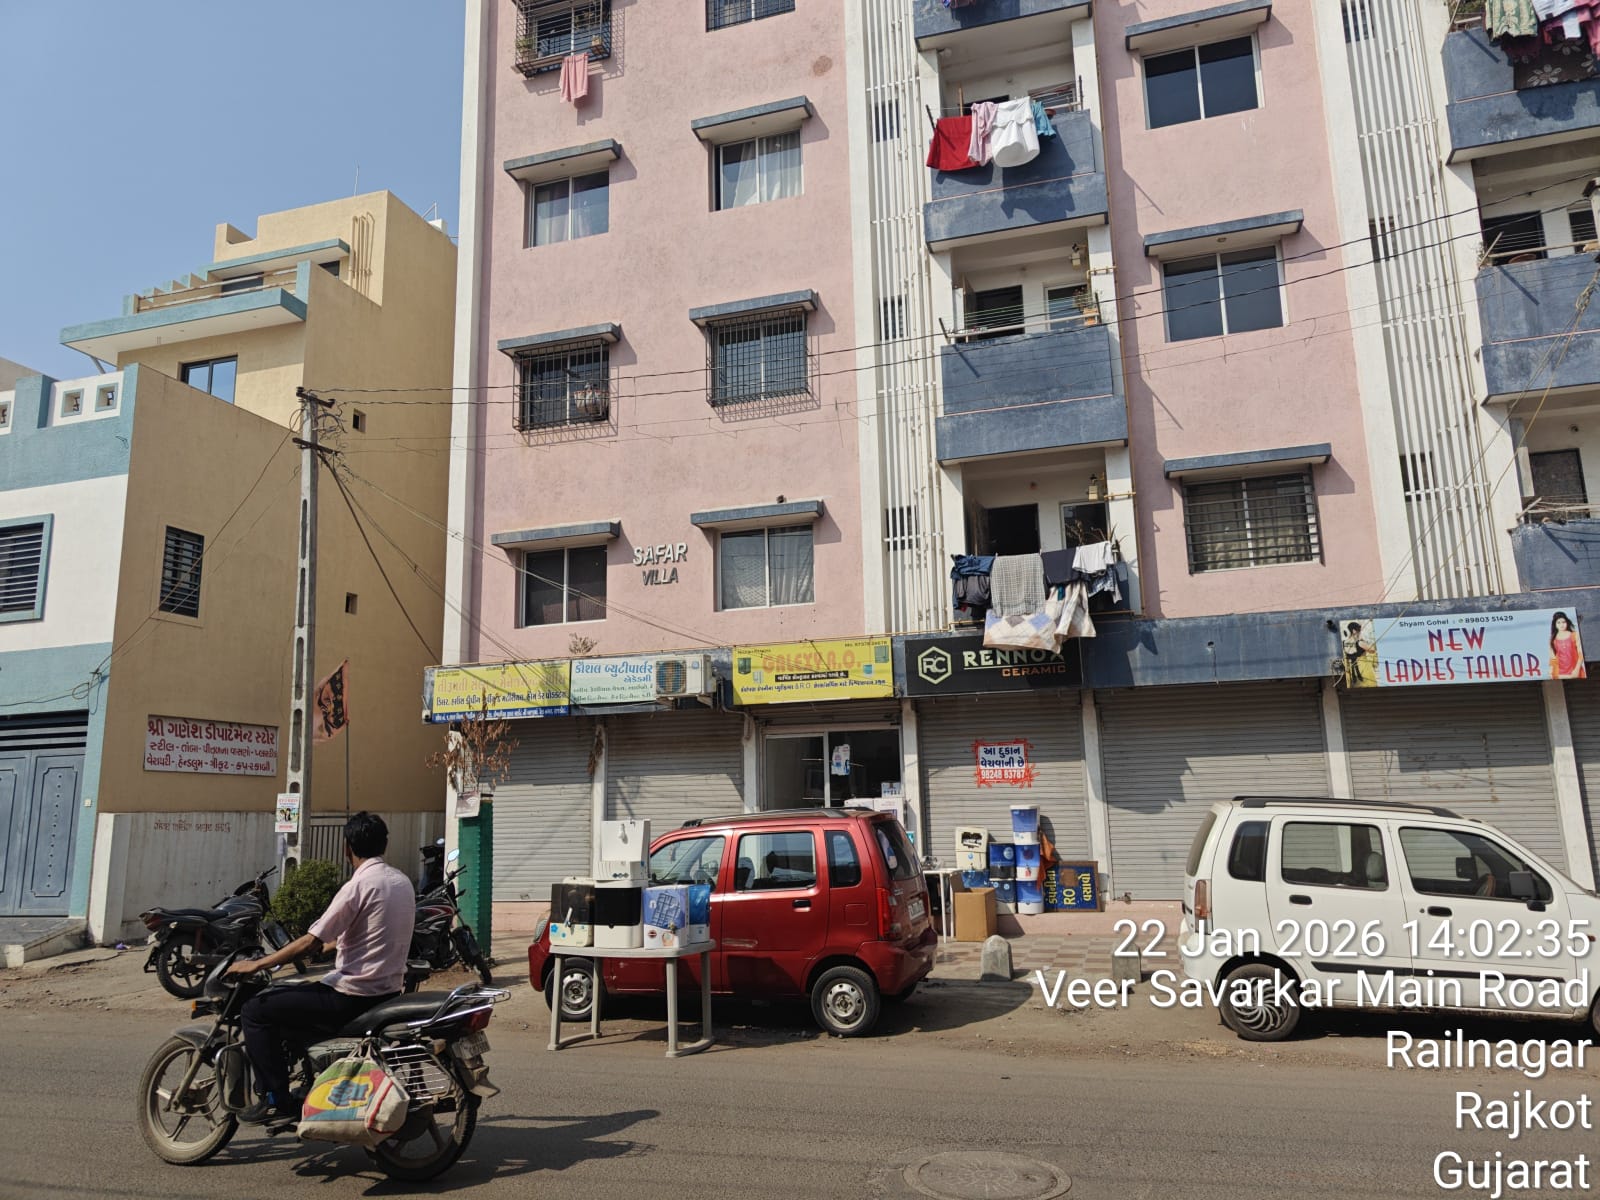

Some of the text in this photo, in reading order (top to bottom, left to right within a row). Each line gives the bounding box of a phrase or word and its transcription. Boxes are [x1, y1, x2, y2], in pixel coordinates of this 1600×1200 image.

[633, 542, 688, 566] SAFAR
[642, 567, 678, 586] VILLA
[1428, 627, 1486, 652] NEW
[1001, 665, 1066, 678] CERAMIC
[1385, 653, 1541, 683] LADIES TAILOR
[148, 718, 165, 737] શ્રી
[167, 719, 203, 739] ગણેશ
[255, 726, 275, 745] સ્ટોર
[983, 746, 1021, 758] આ દુકાન
[980, 756, 1025, 768] વેચવાની છે
[1062, 888, 1077, 906] RO
